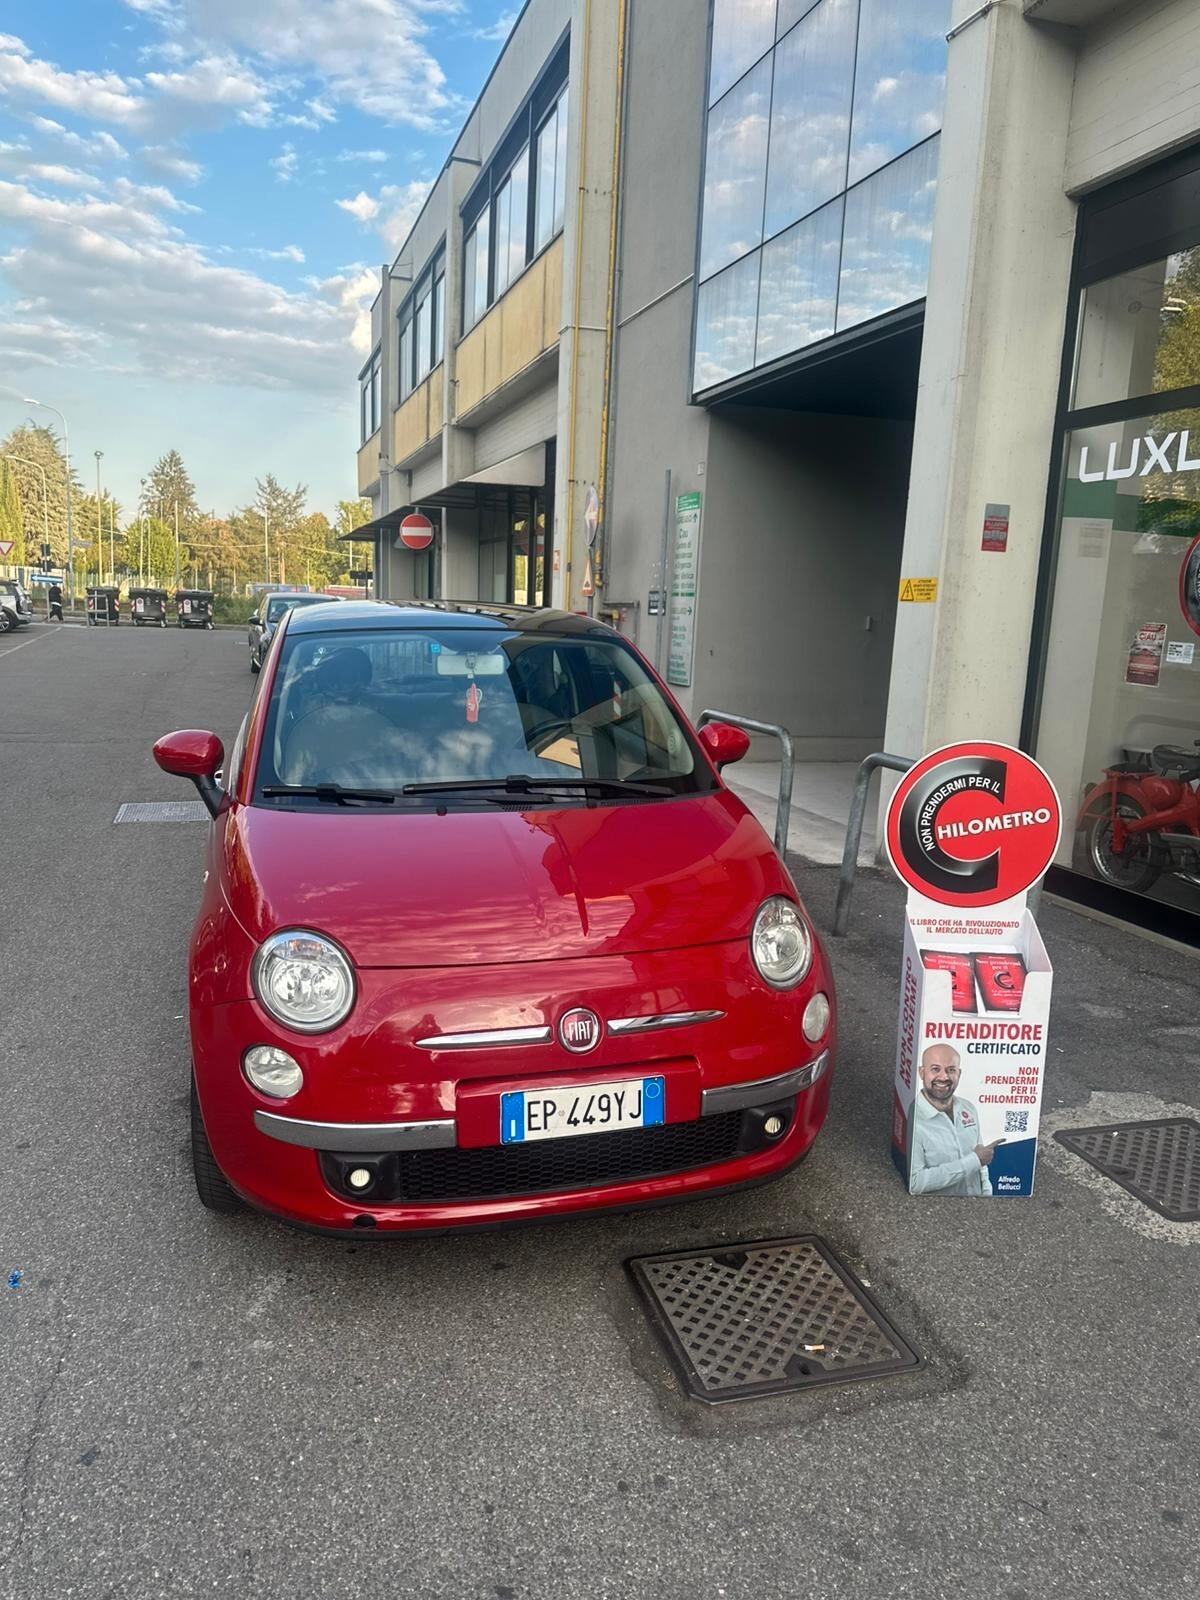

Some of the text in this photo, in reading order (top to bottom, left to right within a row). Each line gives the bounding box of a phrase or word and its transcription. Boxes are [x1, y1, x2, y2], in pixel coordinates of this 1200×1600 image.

[920, 776, 1001, 852] NON PRENDERMI PER IL
[916, 918, 937, 926] LIBRO
[938, 919, 952, 927] CHE
[952, 919, 963, 927] HA
[965, 920, 1020, 928] RIVOLUZIONATO
[935, 926, 967, 934] MERCATO
[968, 927, 1003, 935] DELL'AUTO
[899, 956, 912, 1081] NON CONTRO
[568, 1020, 592, 1042] FIAT
[904, 975, 918, 1090] MA INSIEME
[925, 1022, 1043, 1040] RIVENDITORE
[966, 1042, 1041, 1055] CERTIFICATO
[1018, 1066, 1039, 1076] NON
[985, 1075, 1039, 1085] PRENDERMI
[1010, 1085, 1038, 1095] PER IL
[978, 1094, 1037, 1104] CHILOMETRO
[527, 1099, 556, 1132] EP
[566, 1089, 642, 1127] 449YJ
[998, 1175, 1021, 1183] Alfredo
